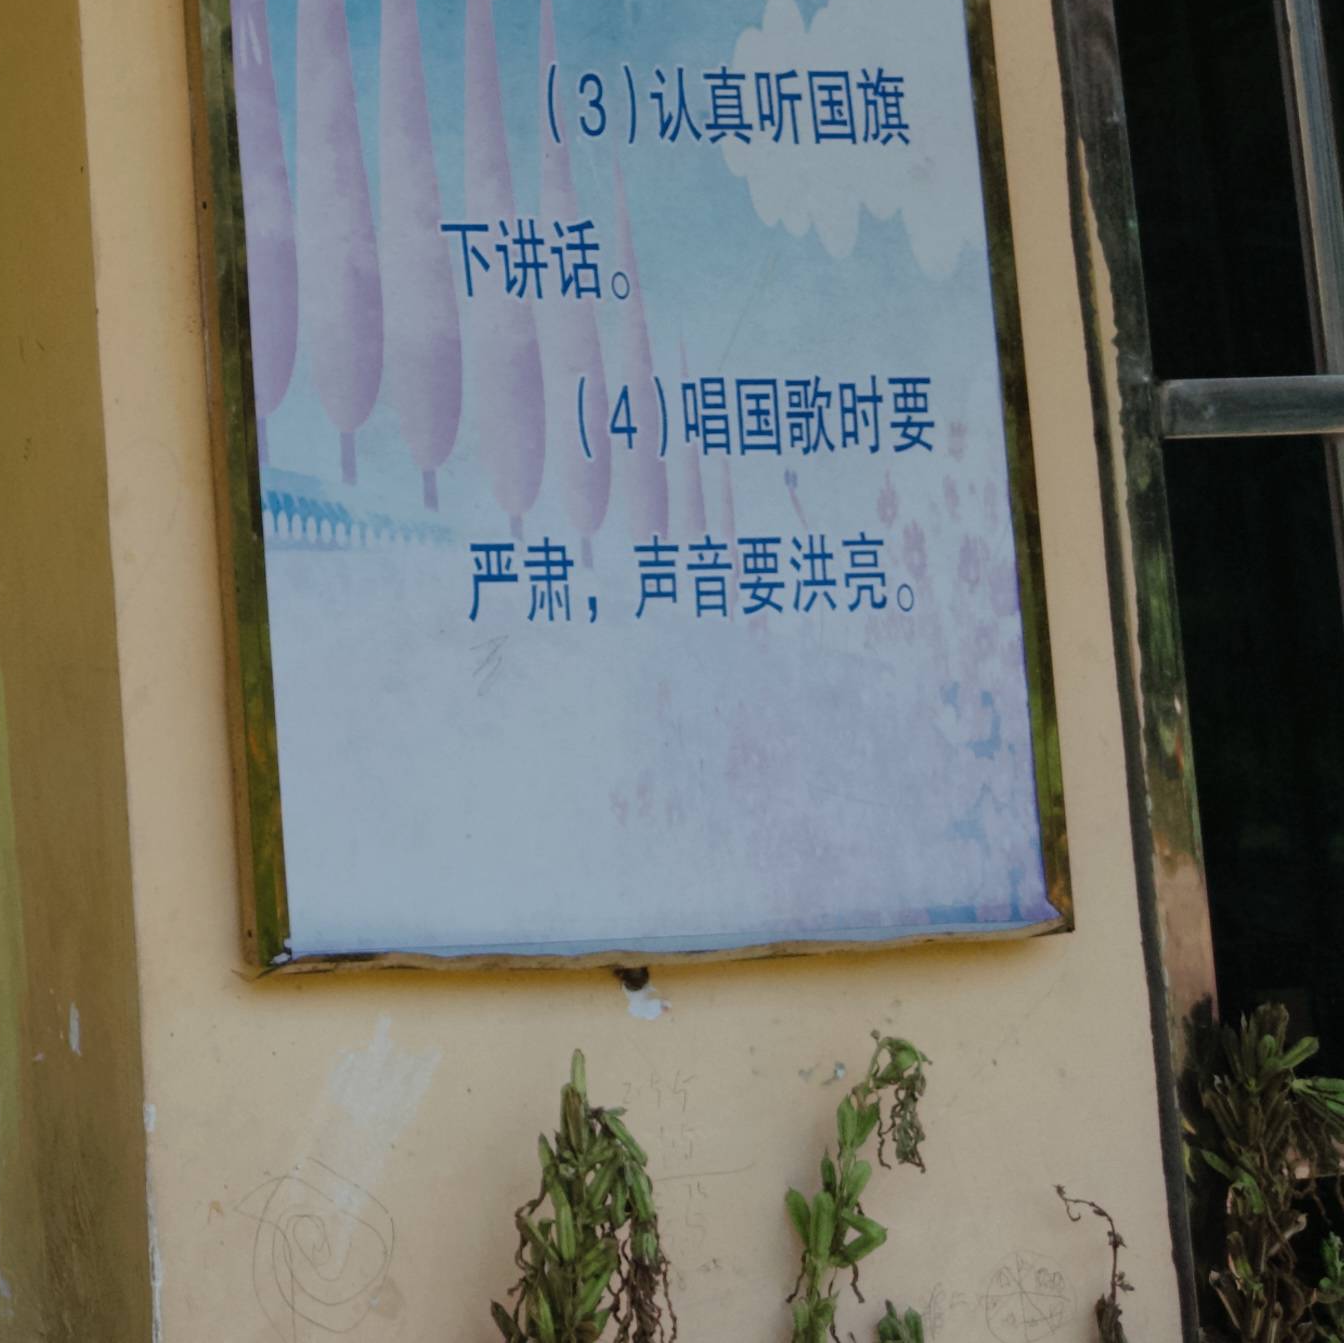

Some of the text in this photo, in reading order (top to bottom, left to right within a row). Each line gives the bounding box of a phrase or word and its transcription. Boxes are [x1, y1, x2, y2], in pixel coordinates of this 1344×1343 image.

[440, 219, 632, 301] 下讲话。
[468, 531, 915, 624] 严肃，声音要洪亮。
